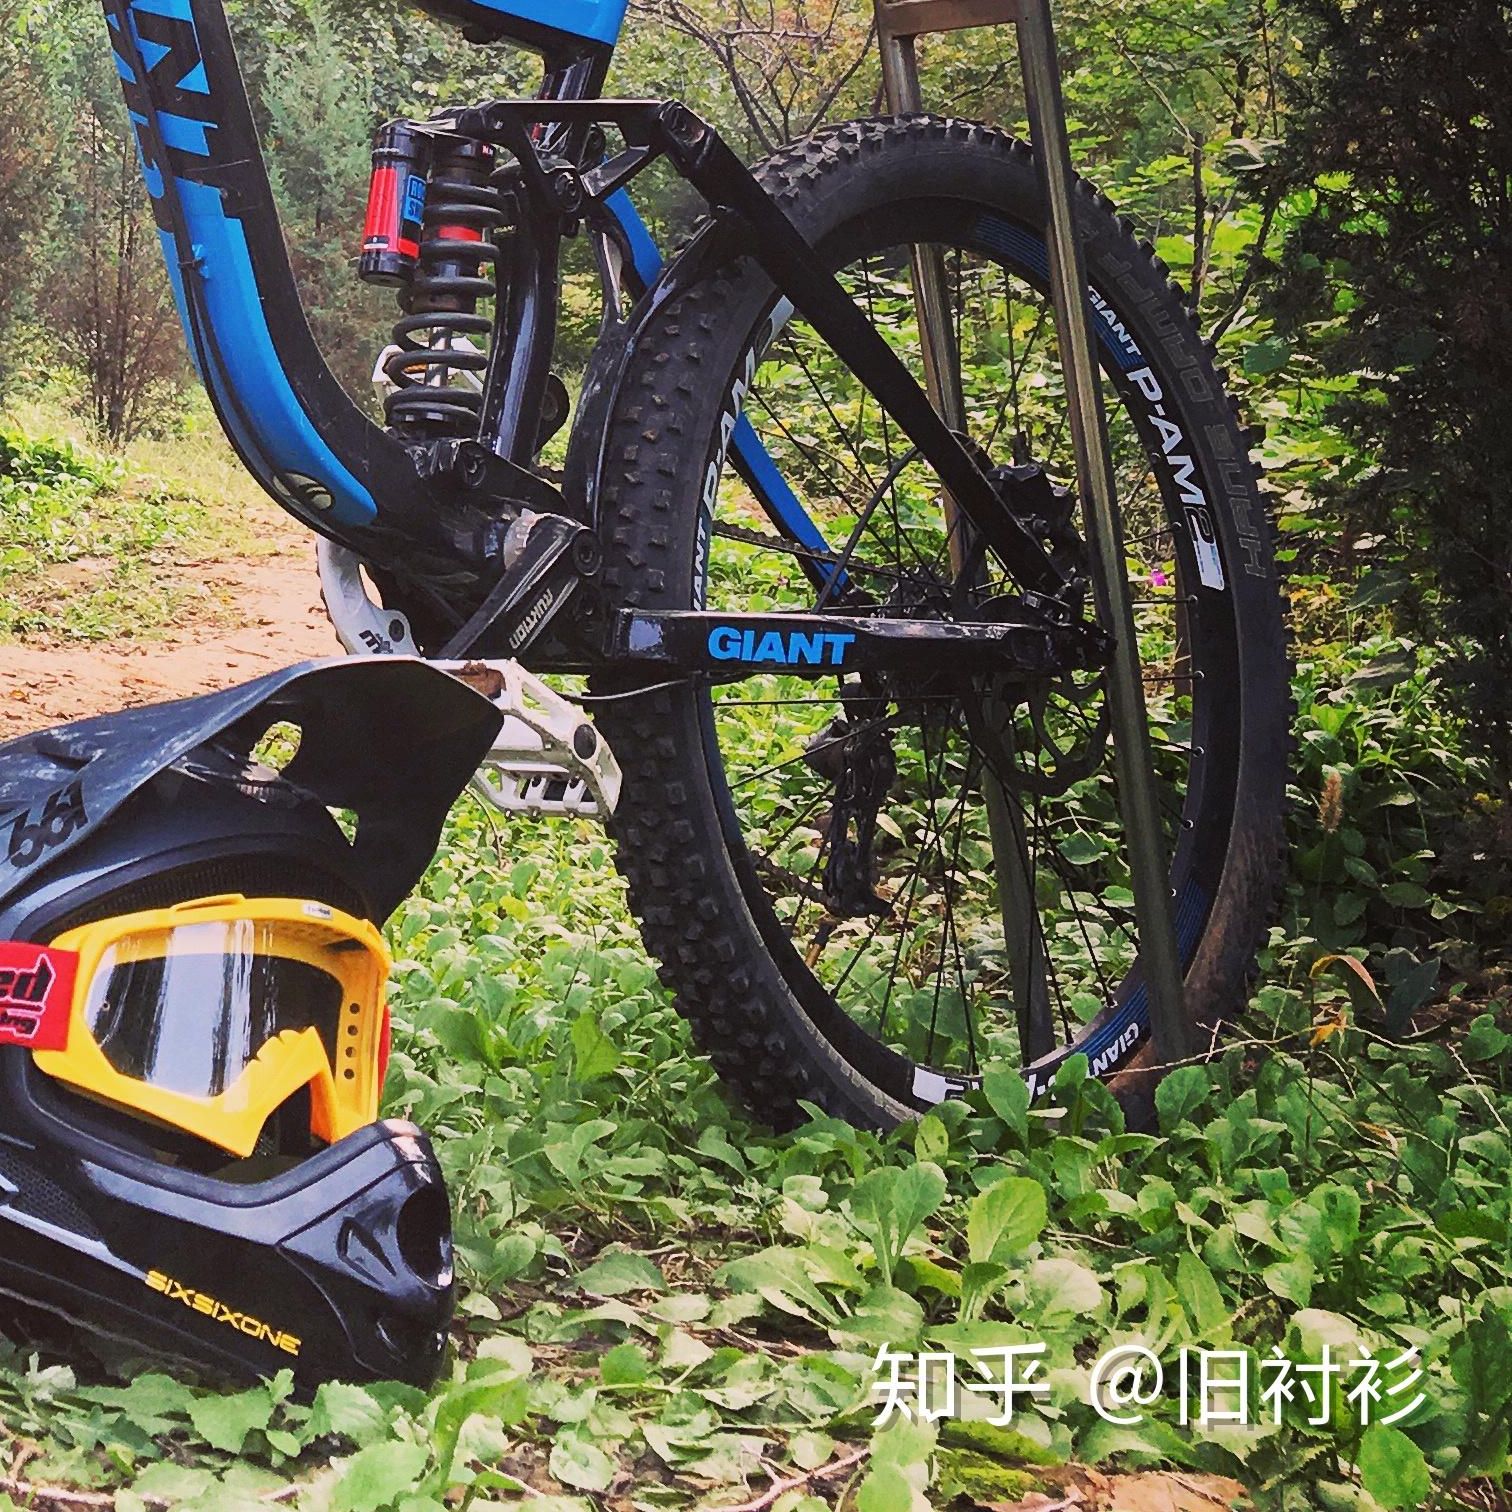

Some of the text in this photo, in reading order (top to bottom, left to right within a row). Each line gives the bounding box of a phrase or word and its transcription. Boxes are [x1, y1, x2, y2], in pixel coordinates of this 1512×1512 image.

[1088, 285, 1143, 357] GIANT
[1127, 366, 1216, 546] P-AM2
[693, 516, 707, 611] IANT
[707, 626, 856, 666] GIANT
[1092, 1021, 1140, 1076] GIAN
[144, 1270, 302, 1356] SIXSIXONE
